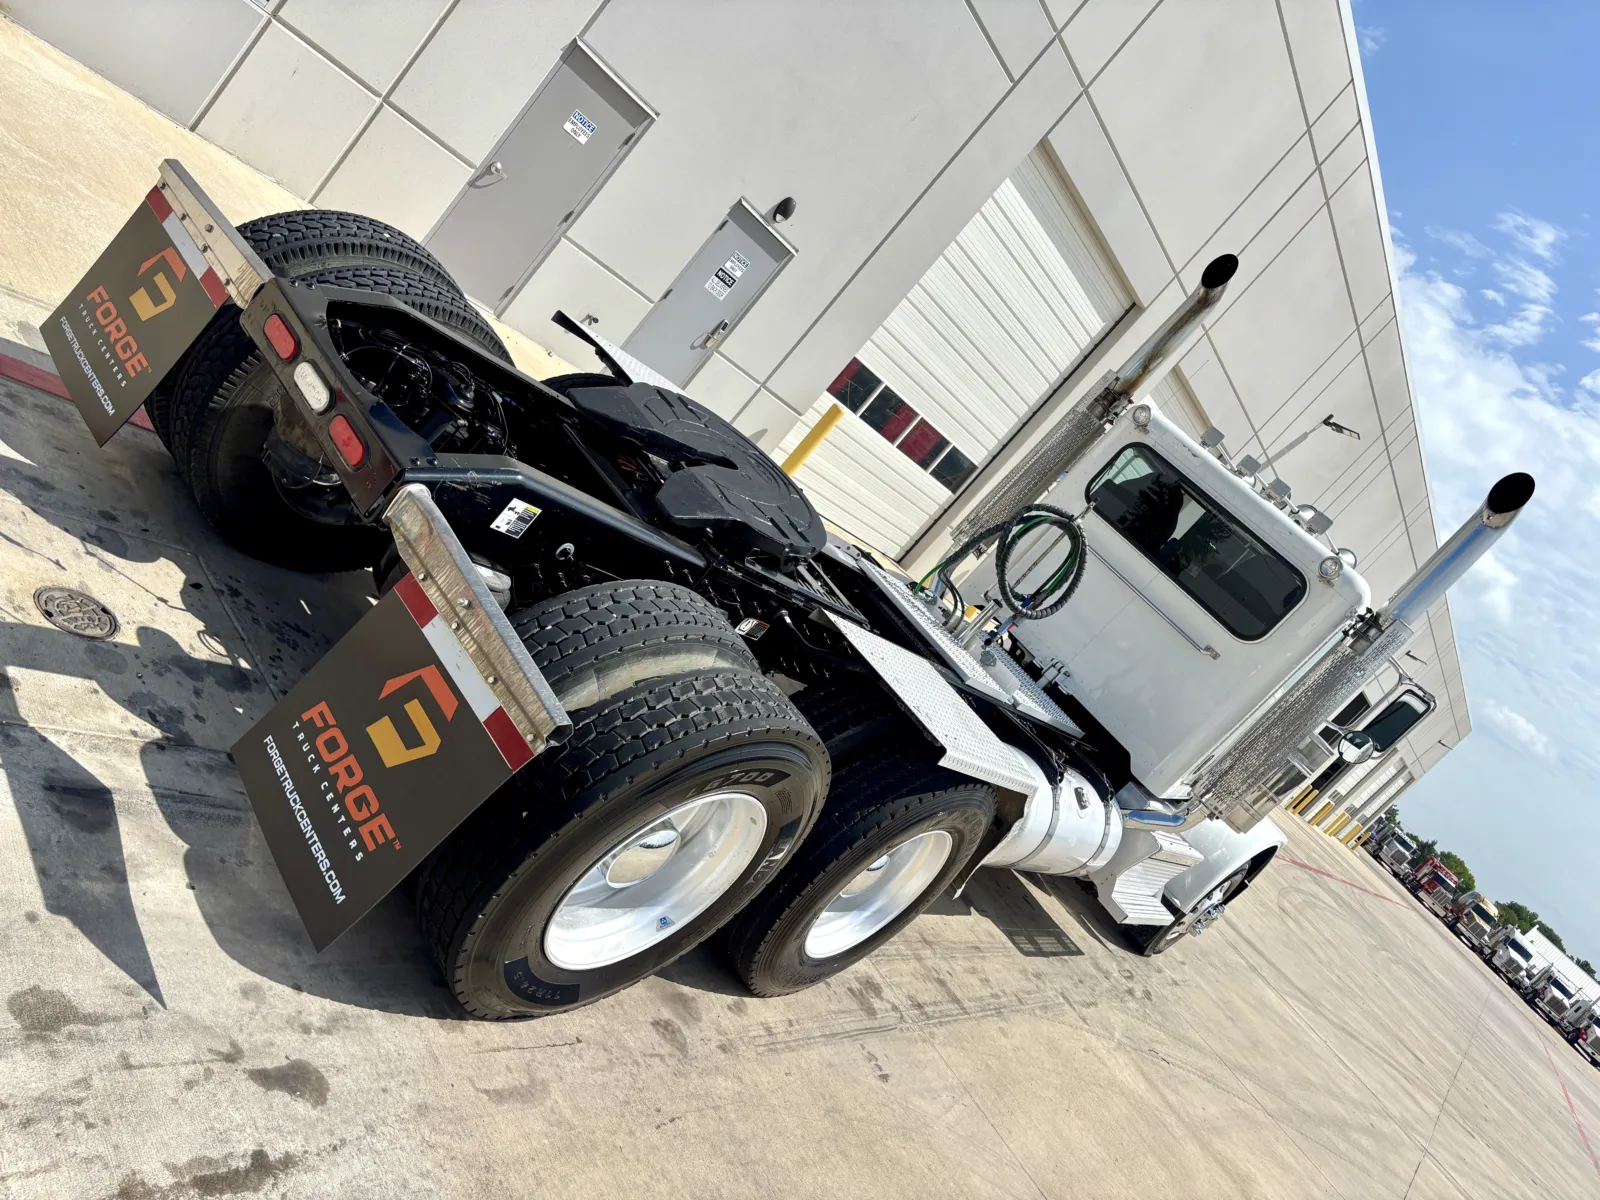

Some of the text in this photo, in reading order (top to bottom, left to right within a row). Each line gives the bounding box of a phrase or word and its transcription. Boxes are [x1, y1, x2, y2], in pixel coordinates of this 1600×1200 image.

[573, 111, 596, 133] NOTICE
[716, 269, 735, 287] NOTICE
[60, 315, 115, 416] FORGETRUCKCENTERS.COM
[78, 303, 126, 387] TRUCK CENTERS
[86, 284, 149, 378] FORGE
[263, 735, 346, 904] FORGETRUCKCENTERS.COM
[292, 721, 363, 862] TRUCK CENTERS
[301, 700, 396, 852] FORGE
